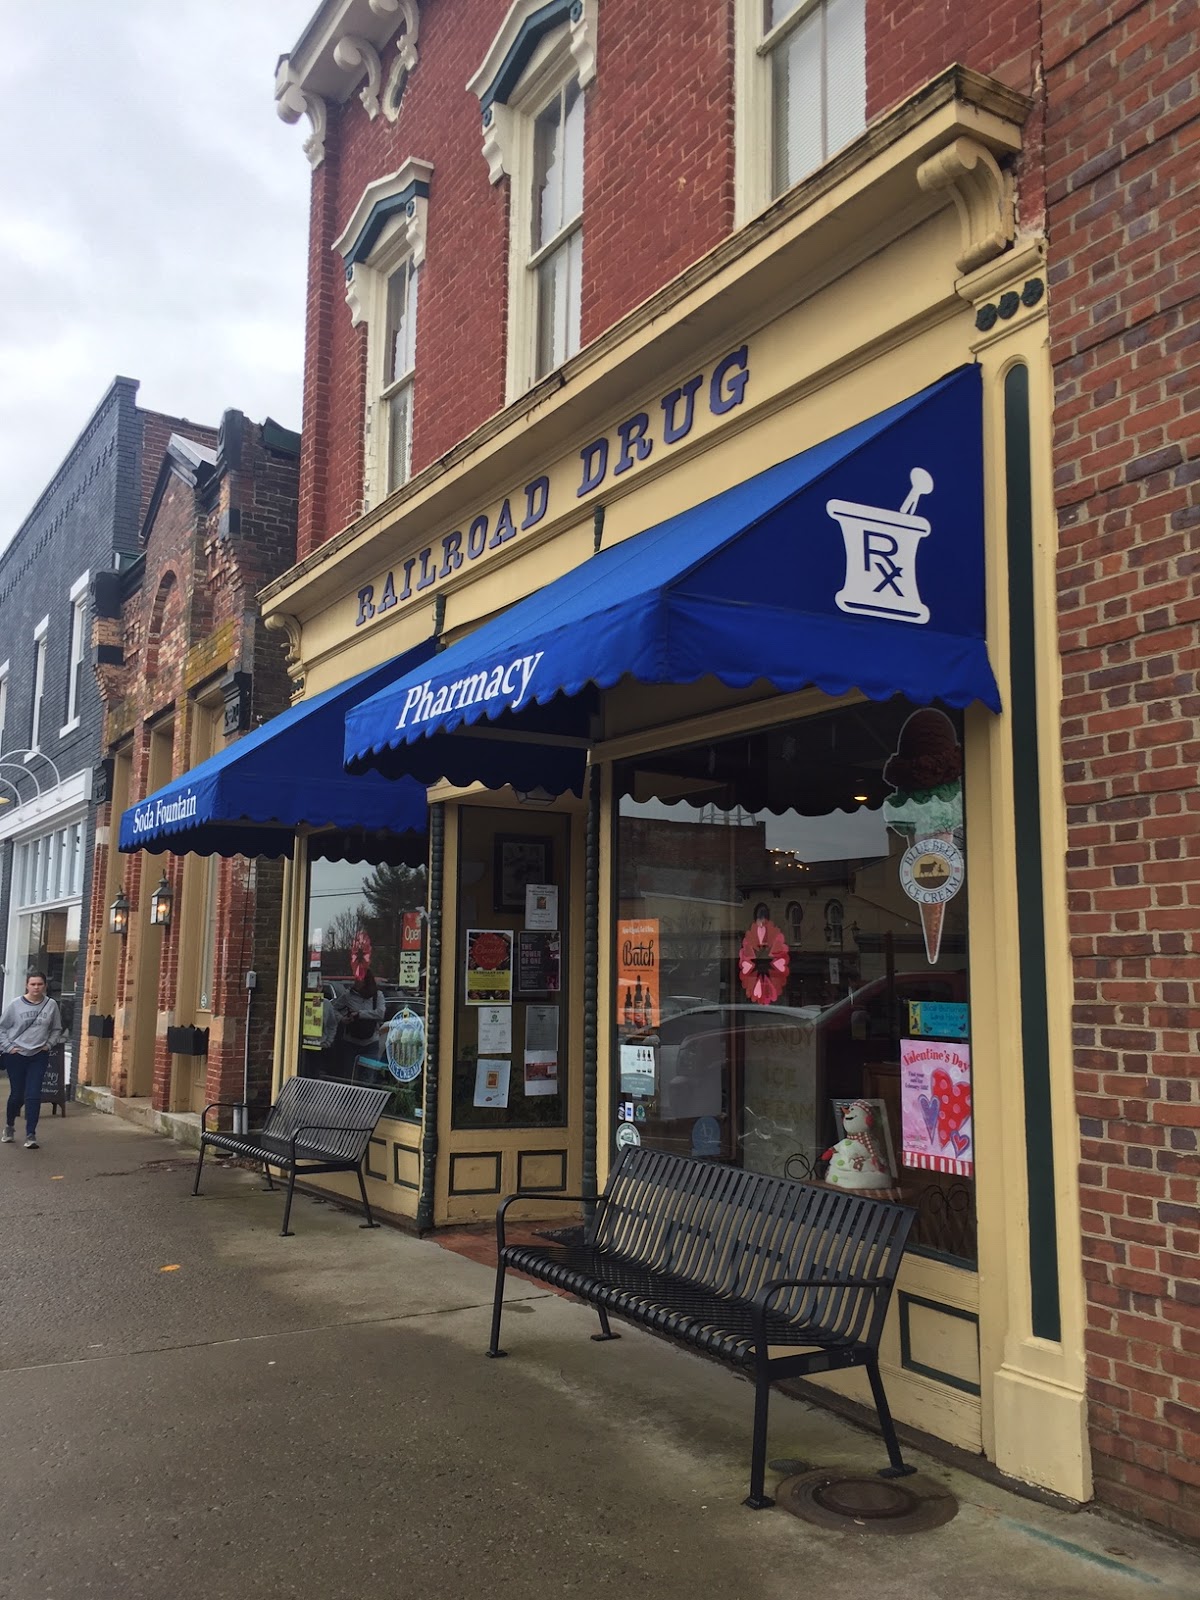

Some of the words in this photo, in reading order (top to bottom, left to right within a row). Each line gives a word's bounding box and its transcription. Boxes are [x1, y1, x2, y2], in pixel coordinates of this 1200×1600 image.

[355, 475, 549, 626] RAILROAD
[577, 345, 749, 498] DRUG
[395, 651, 544, 730] Pharmacy
[133, 807, 154, 833] Soda
[155, 787, 197, 828] Fountain
[904, 841, 930, 867] BLUE
[932, 839, 960, 862] BELL
[904, 880, 920, 901] ICE
[922, 875, 960, 903] CREAM
[622, 939, 655, 966] Batch
[903, 1048, 950, 1066] Valentine's
[951, 1053, 970, 1073] Day
